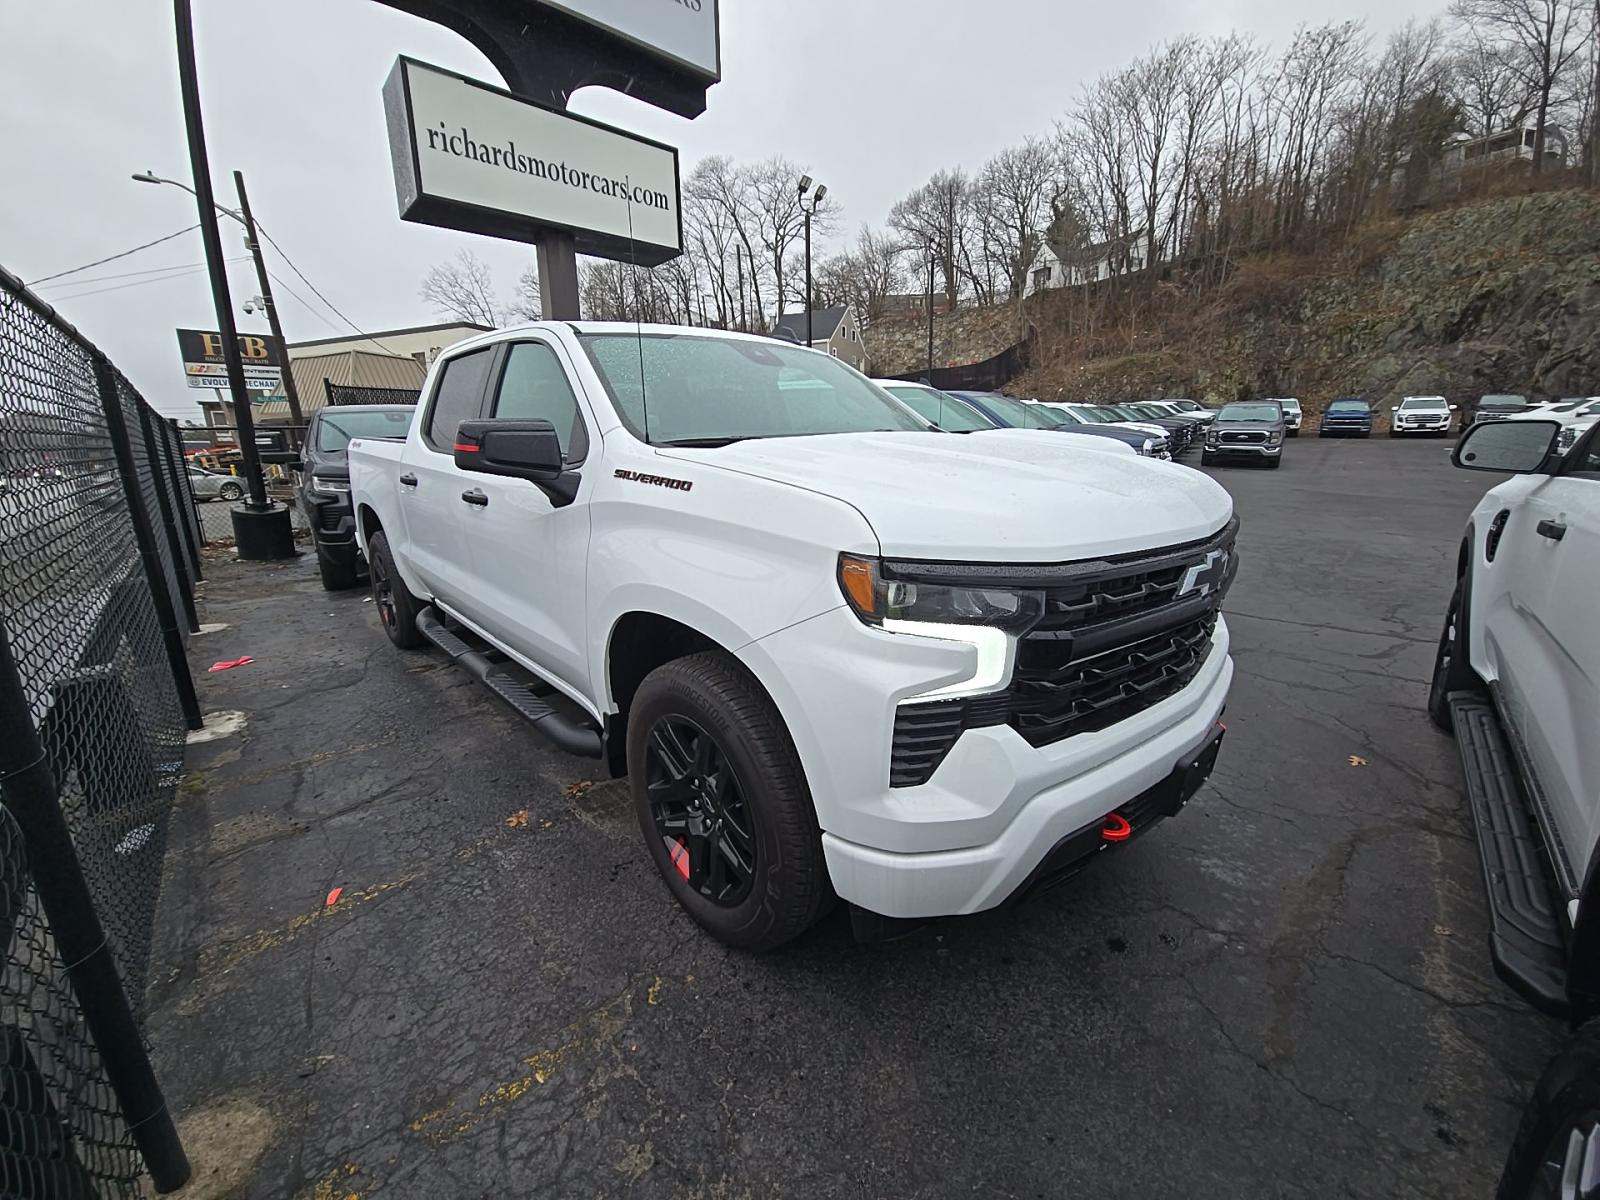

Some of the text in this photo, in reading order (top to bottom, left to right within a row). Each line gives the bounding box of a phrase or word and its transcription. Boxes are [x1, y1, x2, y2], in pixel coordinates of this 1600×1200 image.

[426, 121, 669, 210] richardsmotorcars.com
[202, 378, 229, 386] EVOLV
[613, 469, 693, 491] SILVERADO
